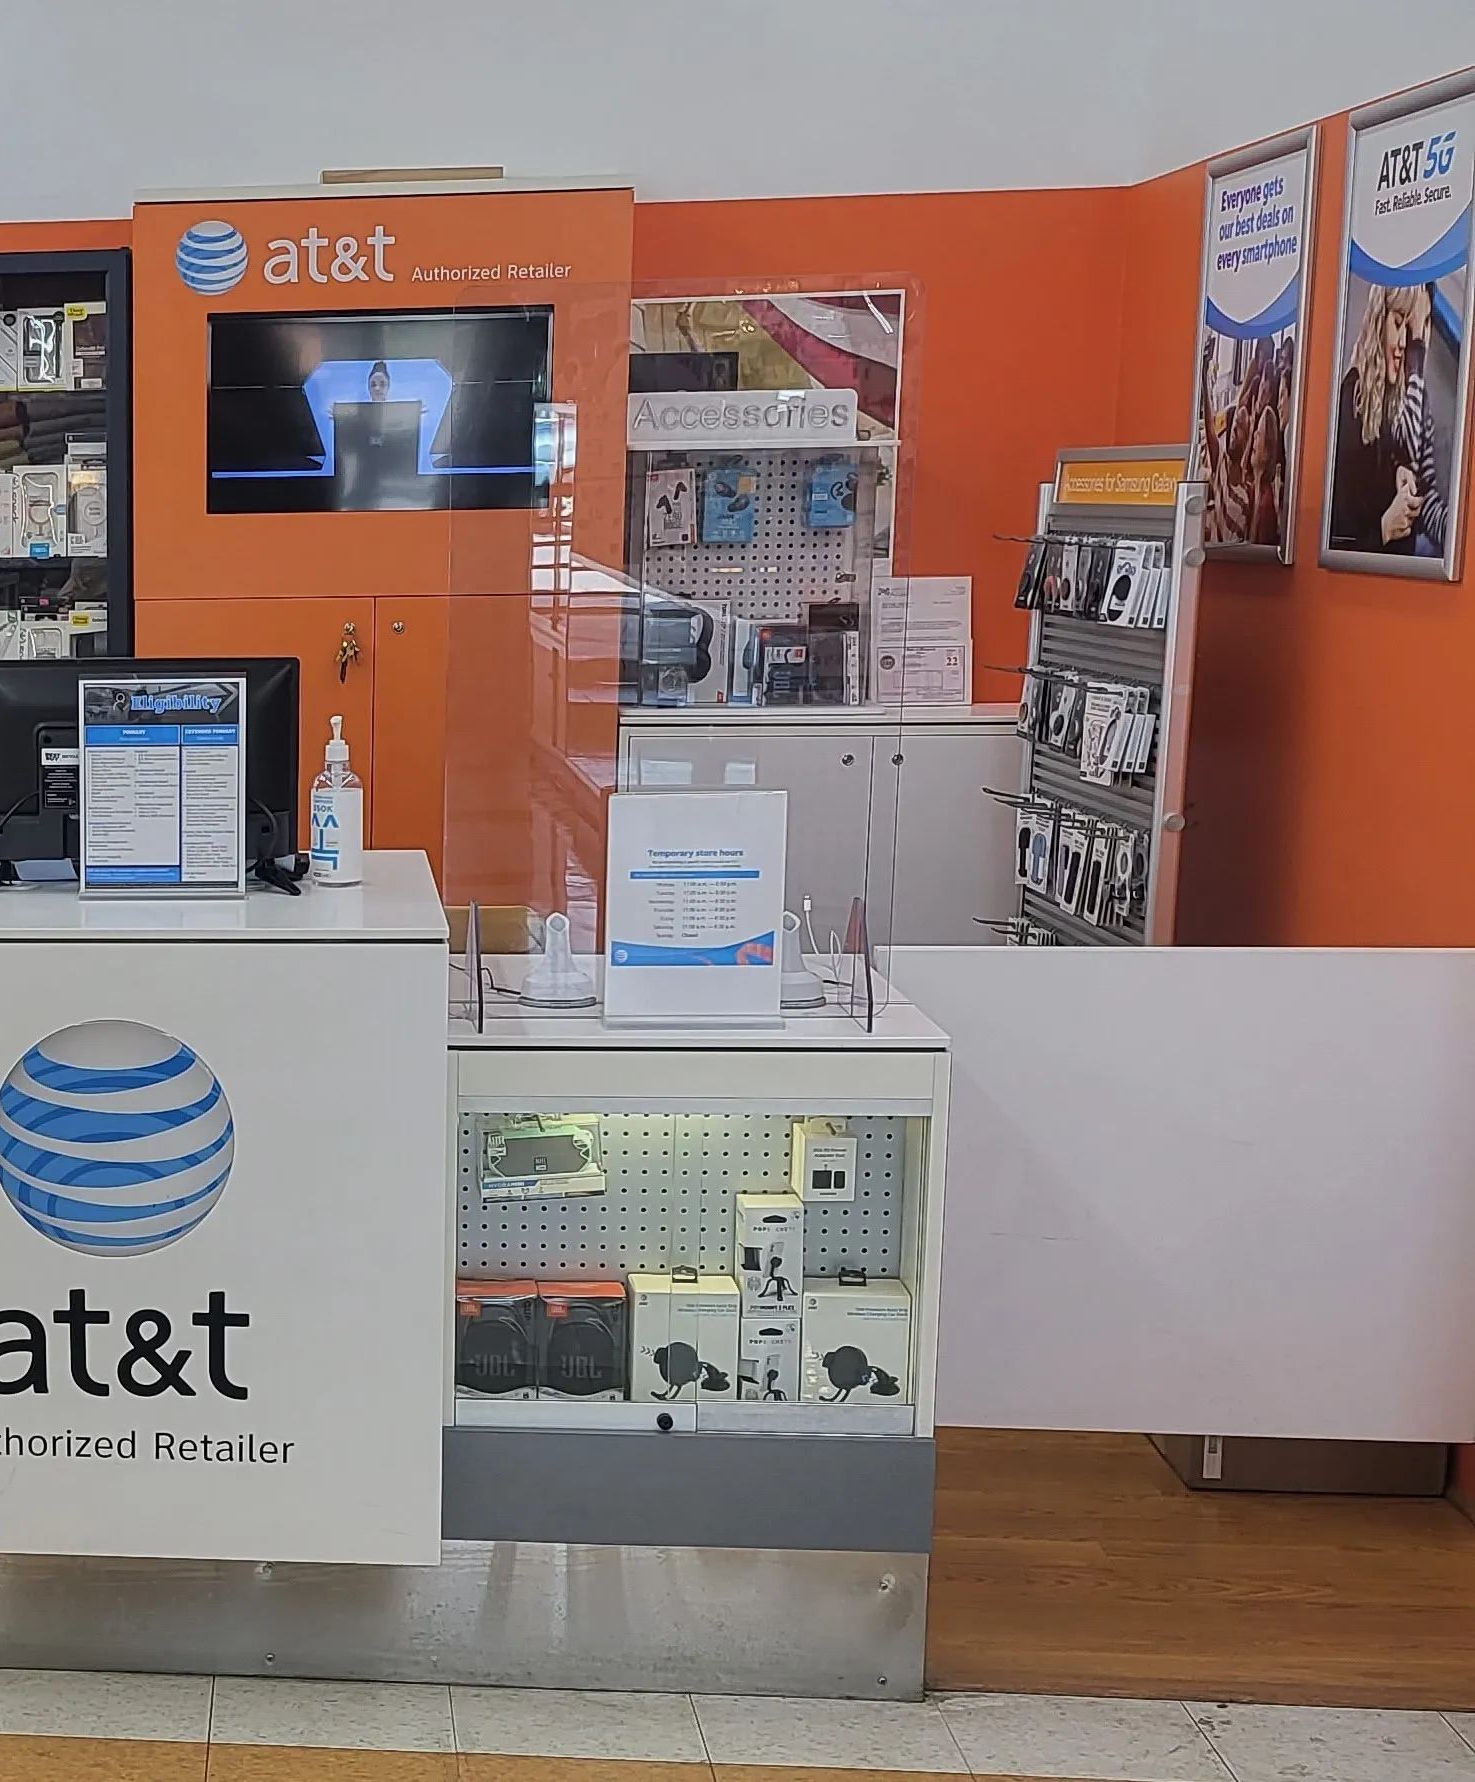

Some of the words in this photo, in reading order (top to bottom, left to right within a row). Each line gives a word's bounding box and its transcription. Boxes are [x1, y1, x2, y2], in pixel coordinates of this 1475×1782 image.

[1377, 141, 1424, 191] AT&T
[1423, 131, 1456, 179] 5G
[1221, 184, 1261, 213] Everyone
[1263, 176, 1283, 206] gets
[1219, 222, 1234, 241] our
[1235, 212, 1254, 236] best
[1256, 204, 1280, 231] deals
[1282, 205, 1293, 225] on
[263, 225, 395, 284] at&t
[412, 264, 501, 283] Authorized
[508, 262, 571, 279] Retailer
[1217, 248, 1241, 272] every
[1242, 234, 1297, 265] smartphone
[633, 399, 849, 430] Accessories
[1116, 473, 1149, 497] Samsung
[130, 694, 222, 714] Eligibility
[648, 850, 694, 858] Temporary
[476, 1354, 516, 1377] JBL
[561, 1355, 602, 1379] JBL
[155, 1432, 295, 1465] Retailer
